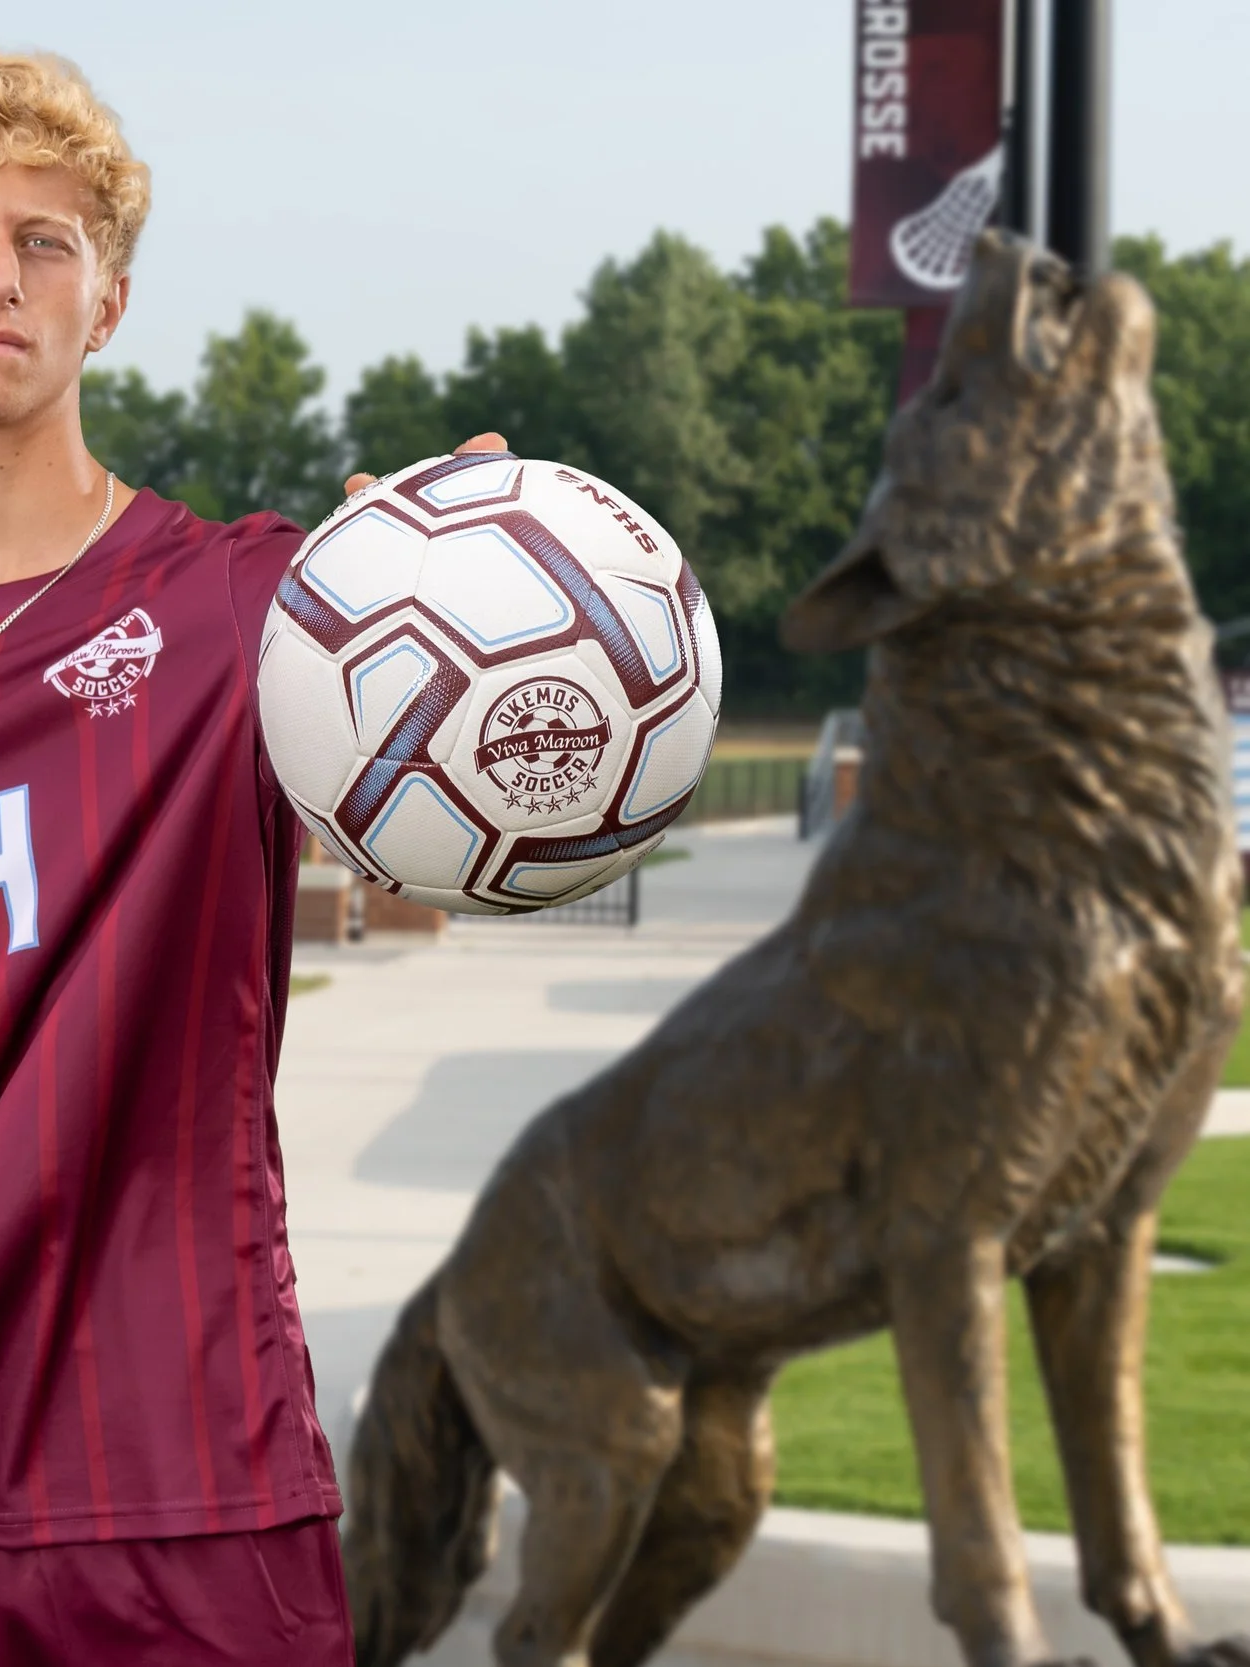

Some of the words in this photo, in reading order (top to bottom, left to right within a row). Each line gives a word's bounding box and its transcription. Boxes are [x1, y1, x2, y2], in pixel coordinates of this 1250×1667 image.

[862, 0, 907, 159] ROSSE
[576, 484, 659, 554] NFHS
[90, 643, 146, 659] Maroon
[72, 663, 141, 696] SOCCER
[497, 687, 579, 727] OKEMOS
[487, 739, 529, 760] Viva
[534, 734, 600, 750] Maroon
[511, 757, 588, 792] SOCCER
